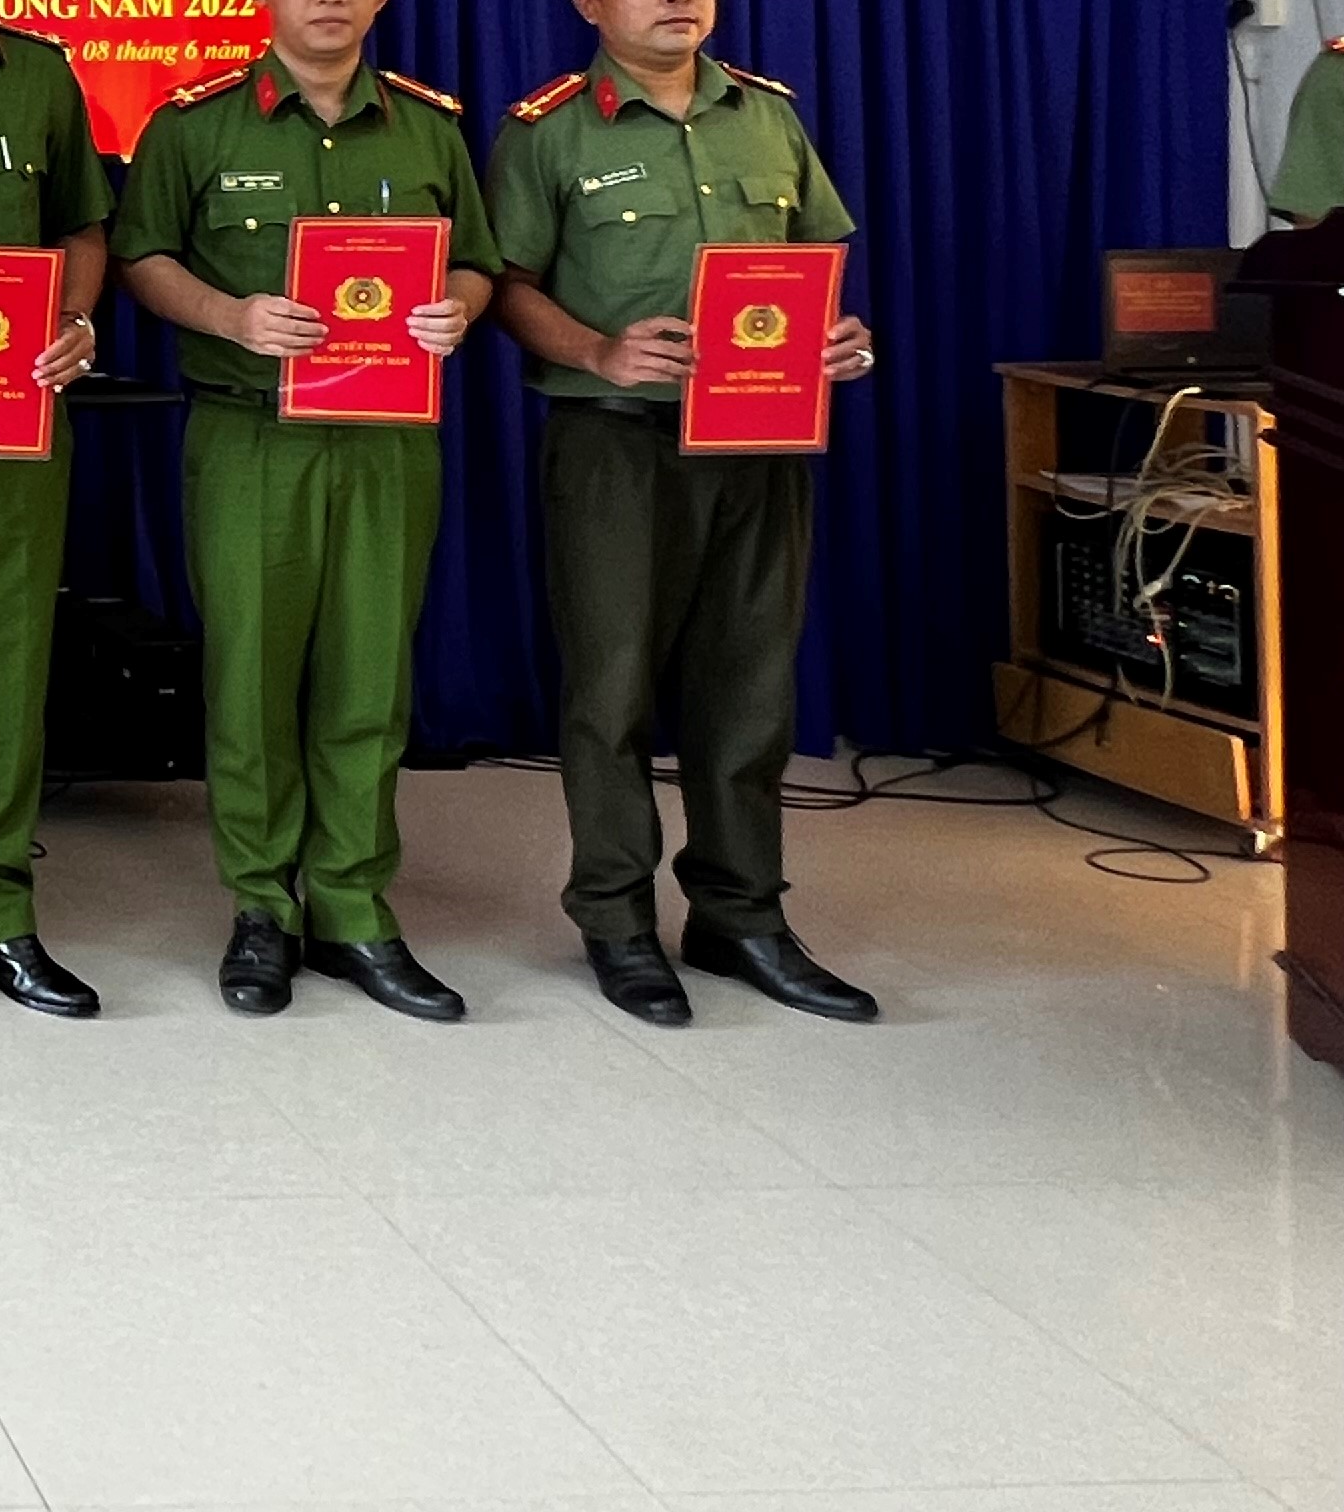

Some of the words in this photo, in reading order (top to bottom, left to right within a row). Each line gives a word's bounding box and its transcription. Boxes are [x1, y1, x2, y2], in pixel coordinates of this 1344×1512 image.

[82, 39, 110, 61] 08
[116, 39, 179, 66] tháng
[184, 39, 198, 61] 6
[204, 39, 250, 61] năm
